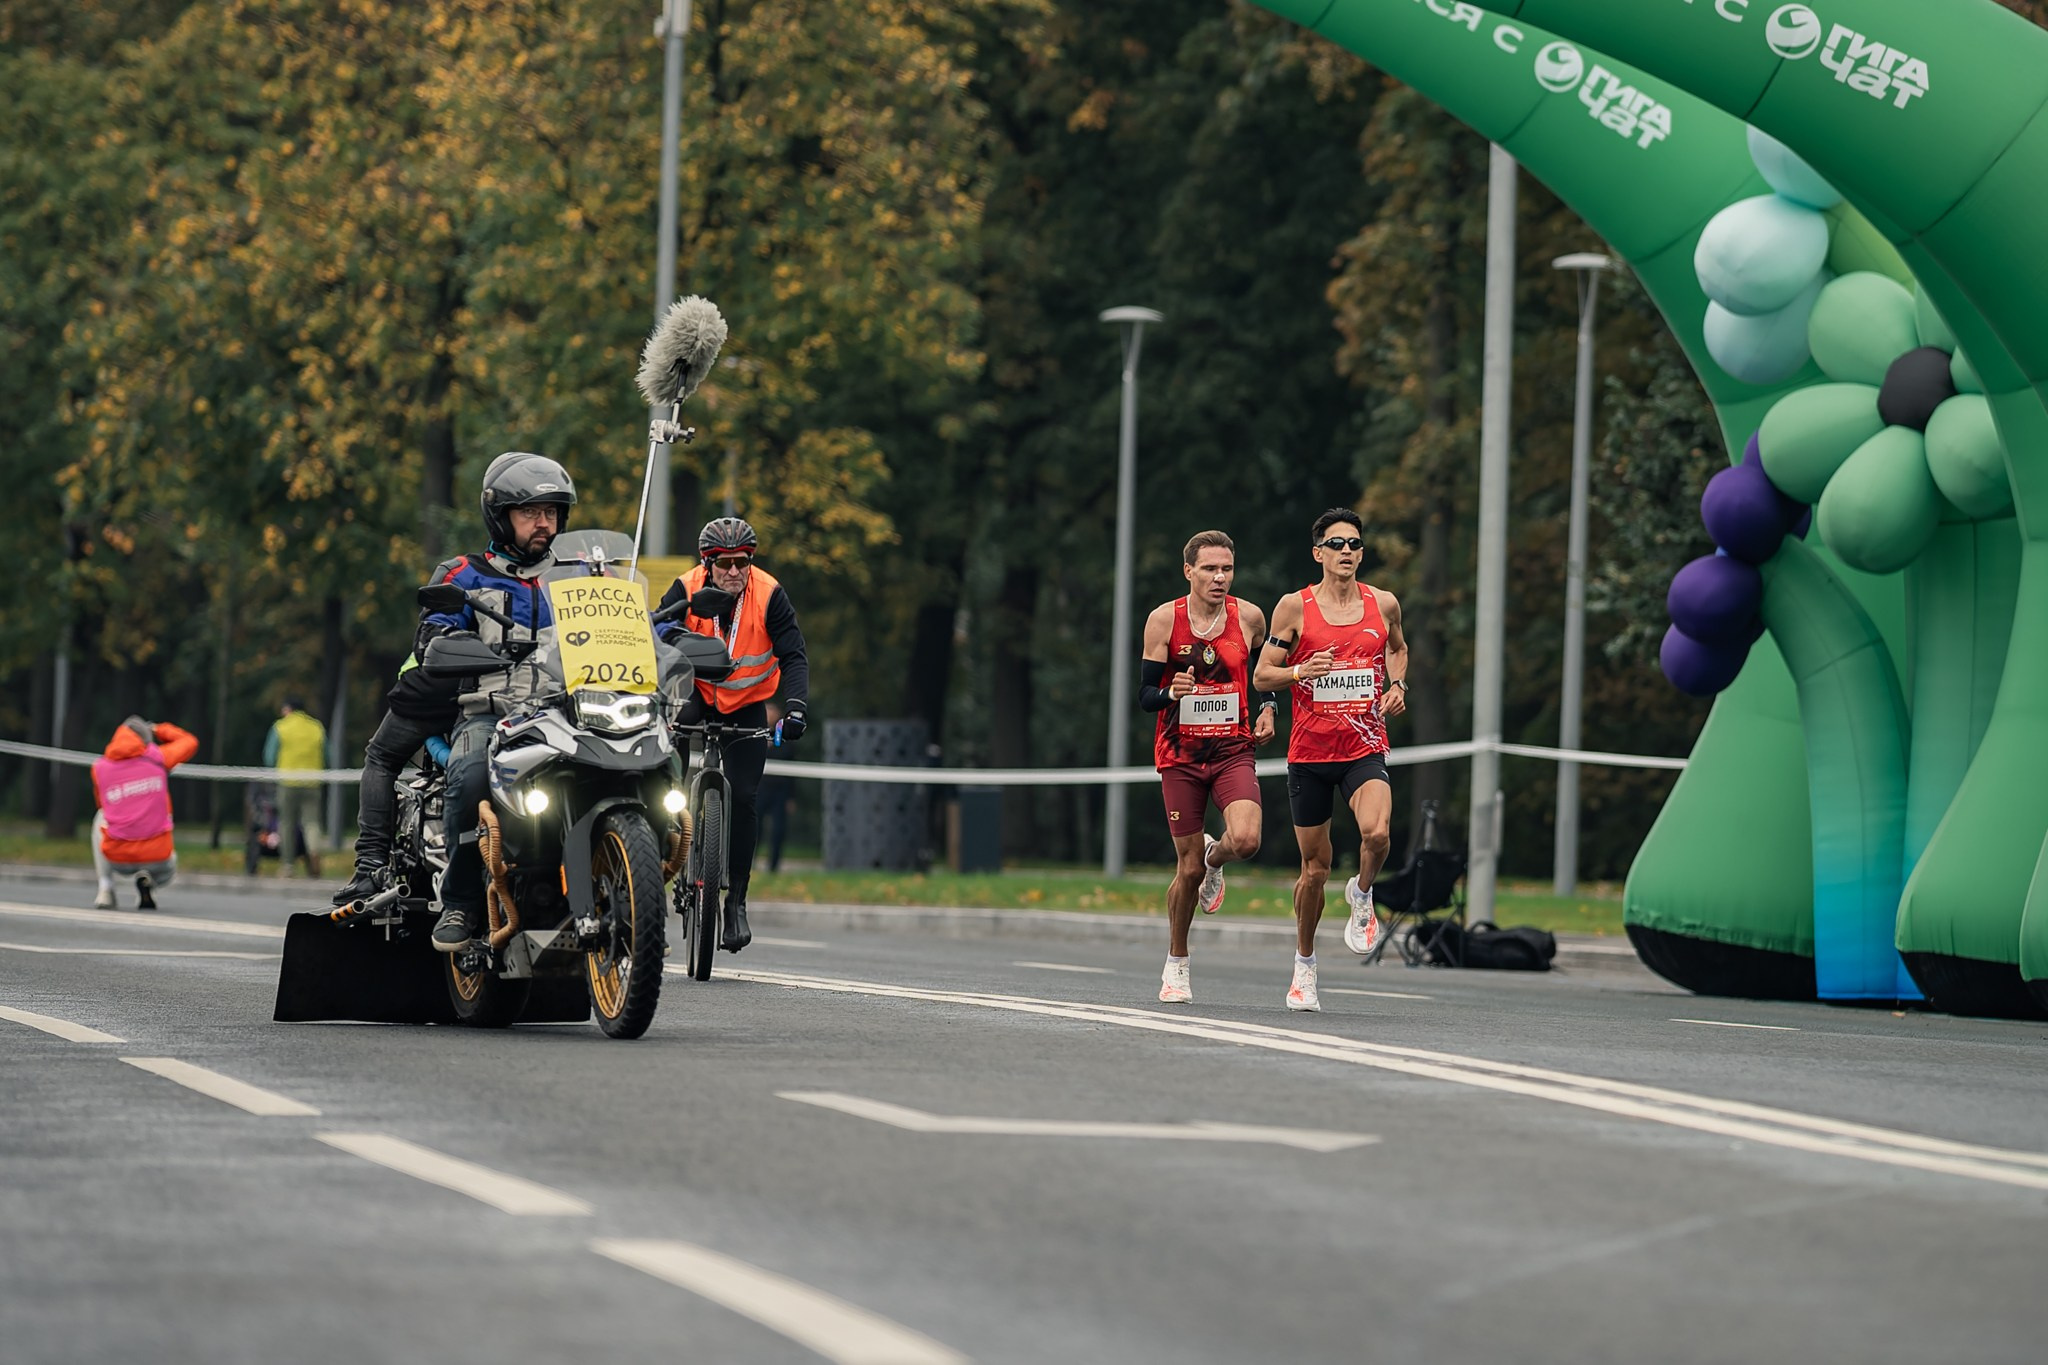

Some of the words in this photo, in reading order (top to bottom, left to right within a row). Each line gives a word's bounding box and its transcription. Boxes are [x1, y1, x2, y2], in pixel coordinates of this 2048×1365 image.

[1825, 22, 1929, 90] ГИГА
[1583, 64, 1672, 136] ГИГА
[562, 587, 636, 605] ТРАССА
[558, 603, 646, 622] ПРОПУСК
[595, 633, 648, 644] МОСКОВСКИЙ
[596, 639, 636, 647] МАРАФОН
[581, 663, 644, 685] 2026
[1316, 675, 1372, 690] АХМАДЕЕВ
[1194, 700, 1228, 713] ПОПОВ
